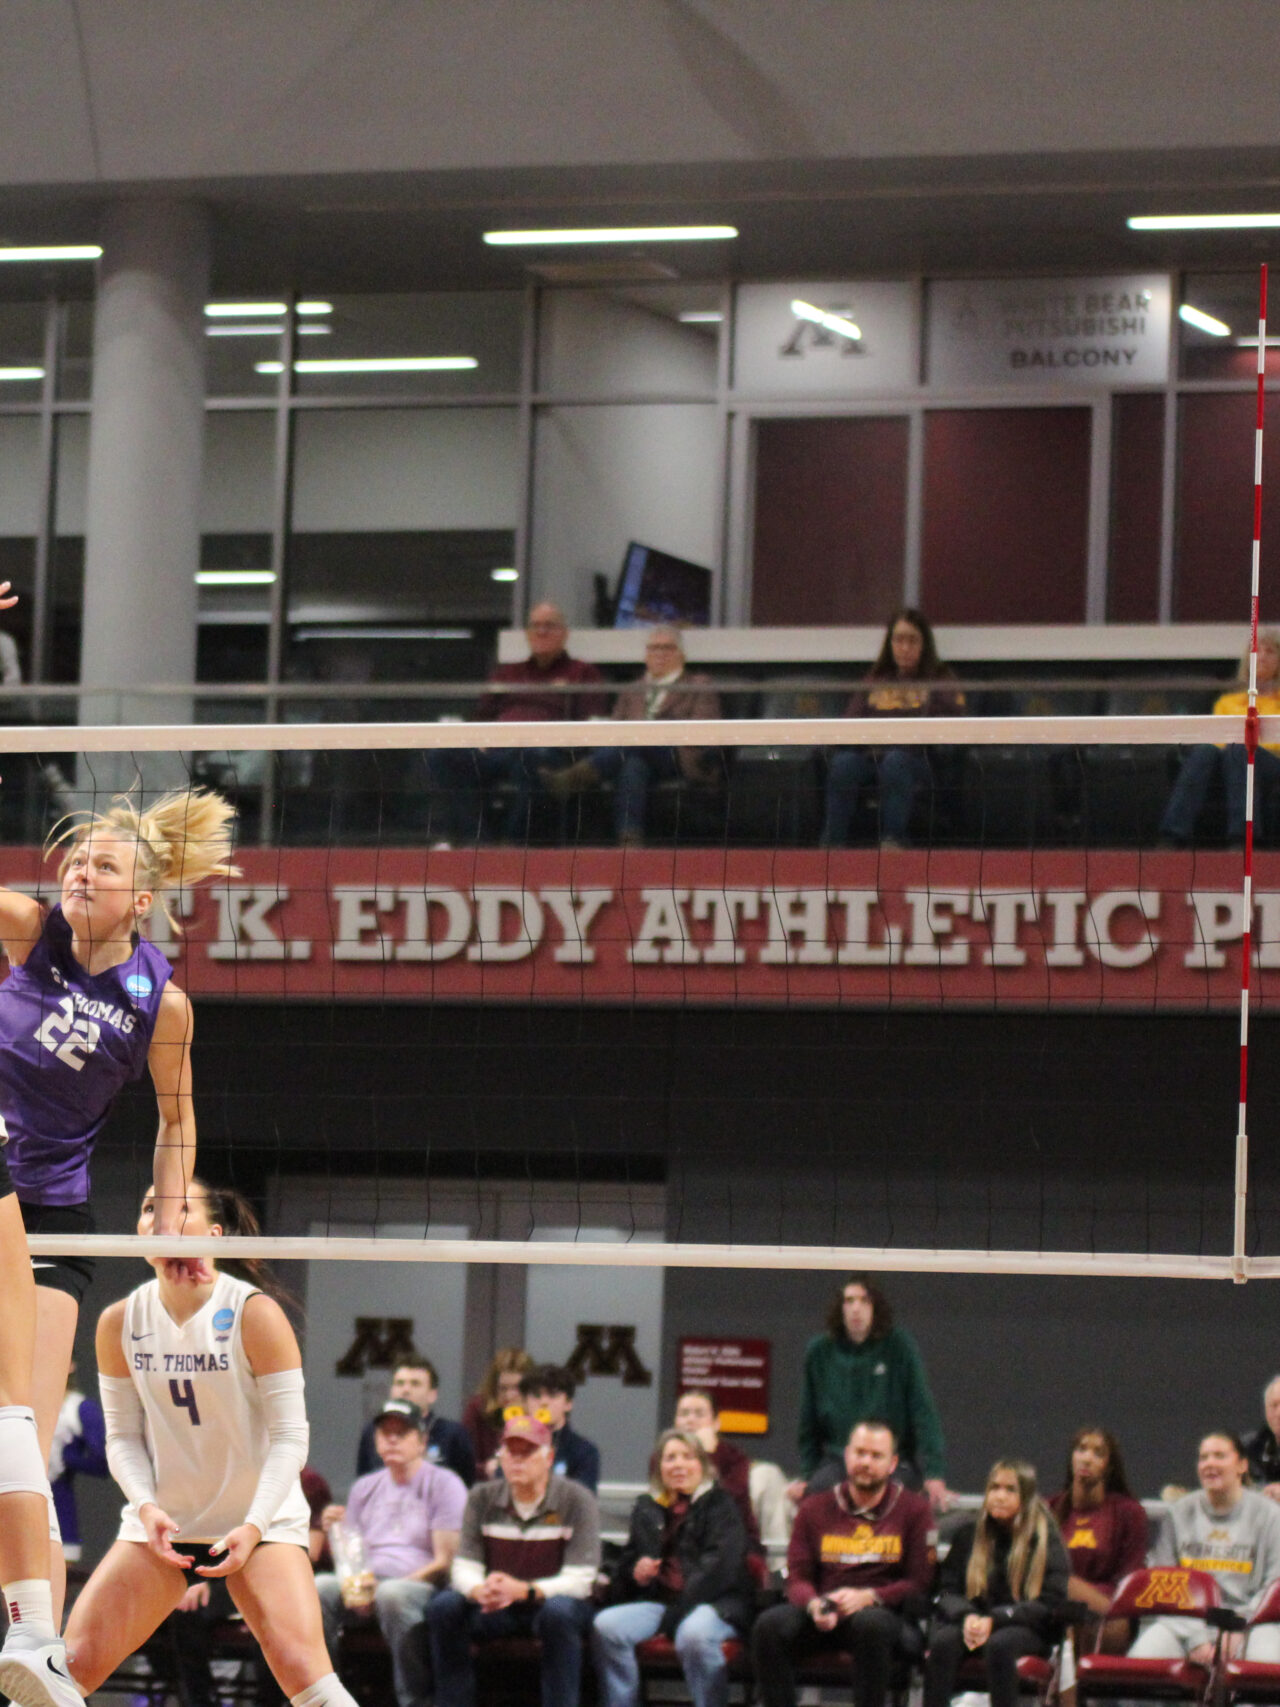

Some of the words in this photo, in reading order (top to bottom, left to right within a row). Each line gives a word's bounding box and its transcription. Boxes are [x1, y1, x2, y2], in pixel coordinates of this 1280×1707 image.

[1010, 348, 1137, 369] BALCONY
[208, 885, 312, 960] K.
[331, 885, 613, 963] EDDY
[626, 886, 1160, 967] ATHLETIC
[33, 996, 101, 1072] 22
[72, 991, 137, 1034] HOMAS
[134, 1352, 158, 1372] ST.
[163, 1353, 230, 1372] THOMAS
[168, 1378, 202, 1427] 4
